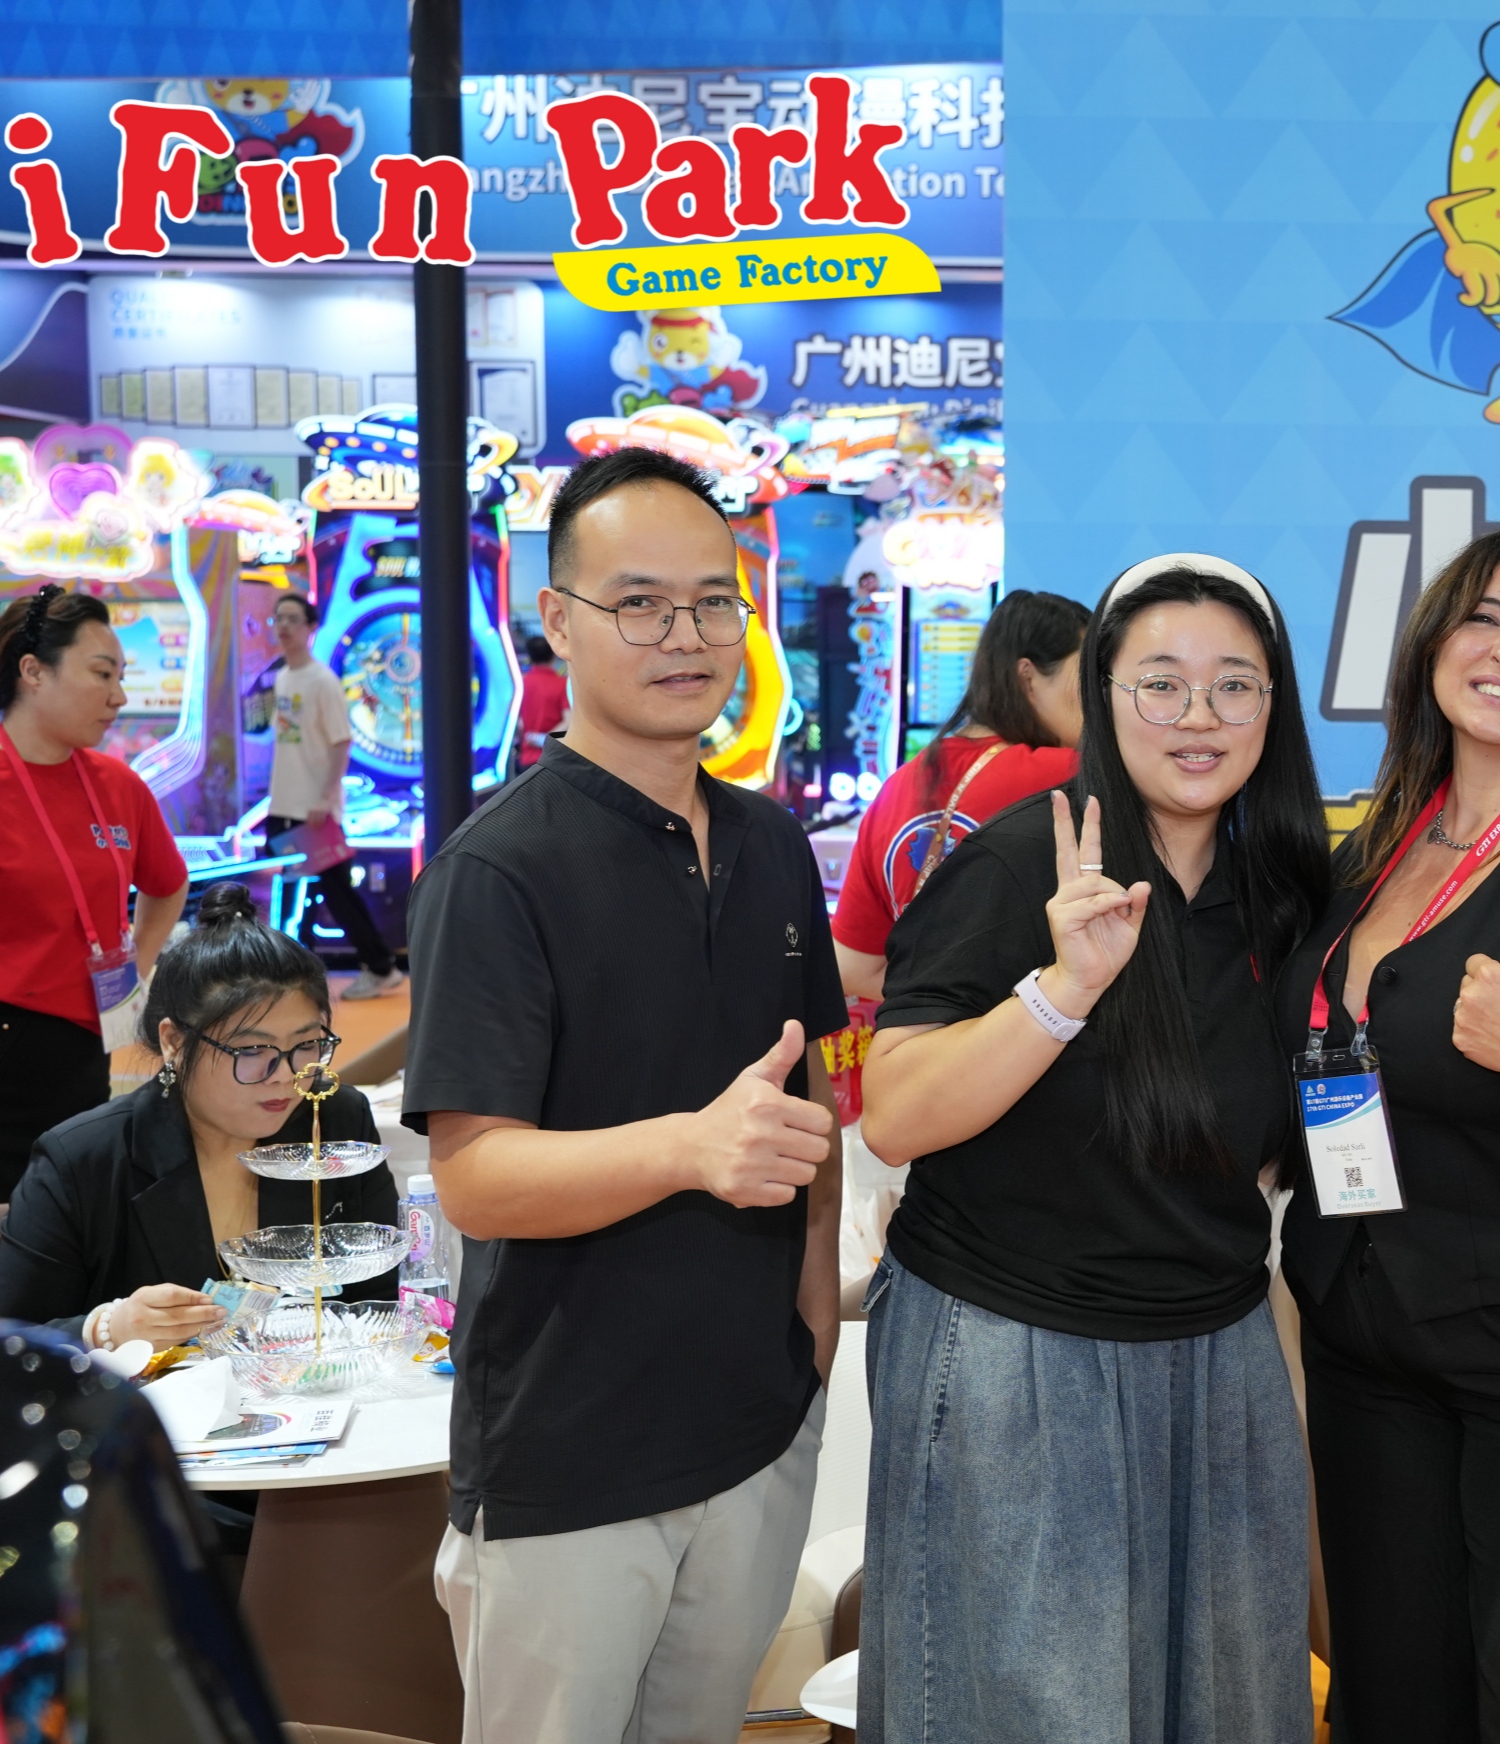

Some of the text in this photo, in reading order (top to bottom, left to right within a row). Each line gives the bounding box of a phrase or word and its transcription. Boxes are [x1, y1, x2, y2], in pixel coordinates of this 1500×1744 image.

[790, 333, 1004, 388] 广州迪尼
[1475, 836, 1492, 858] GTI
[1338, 1189, 1377, 1201] 海外买家
[1336, 1199, 1382, 1210] Overseas Buyer
